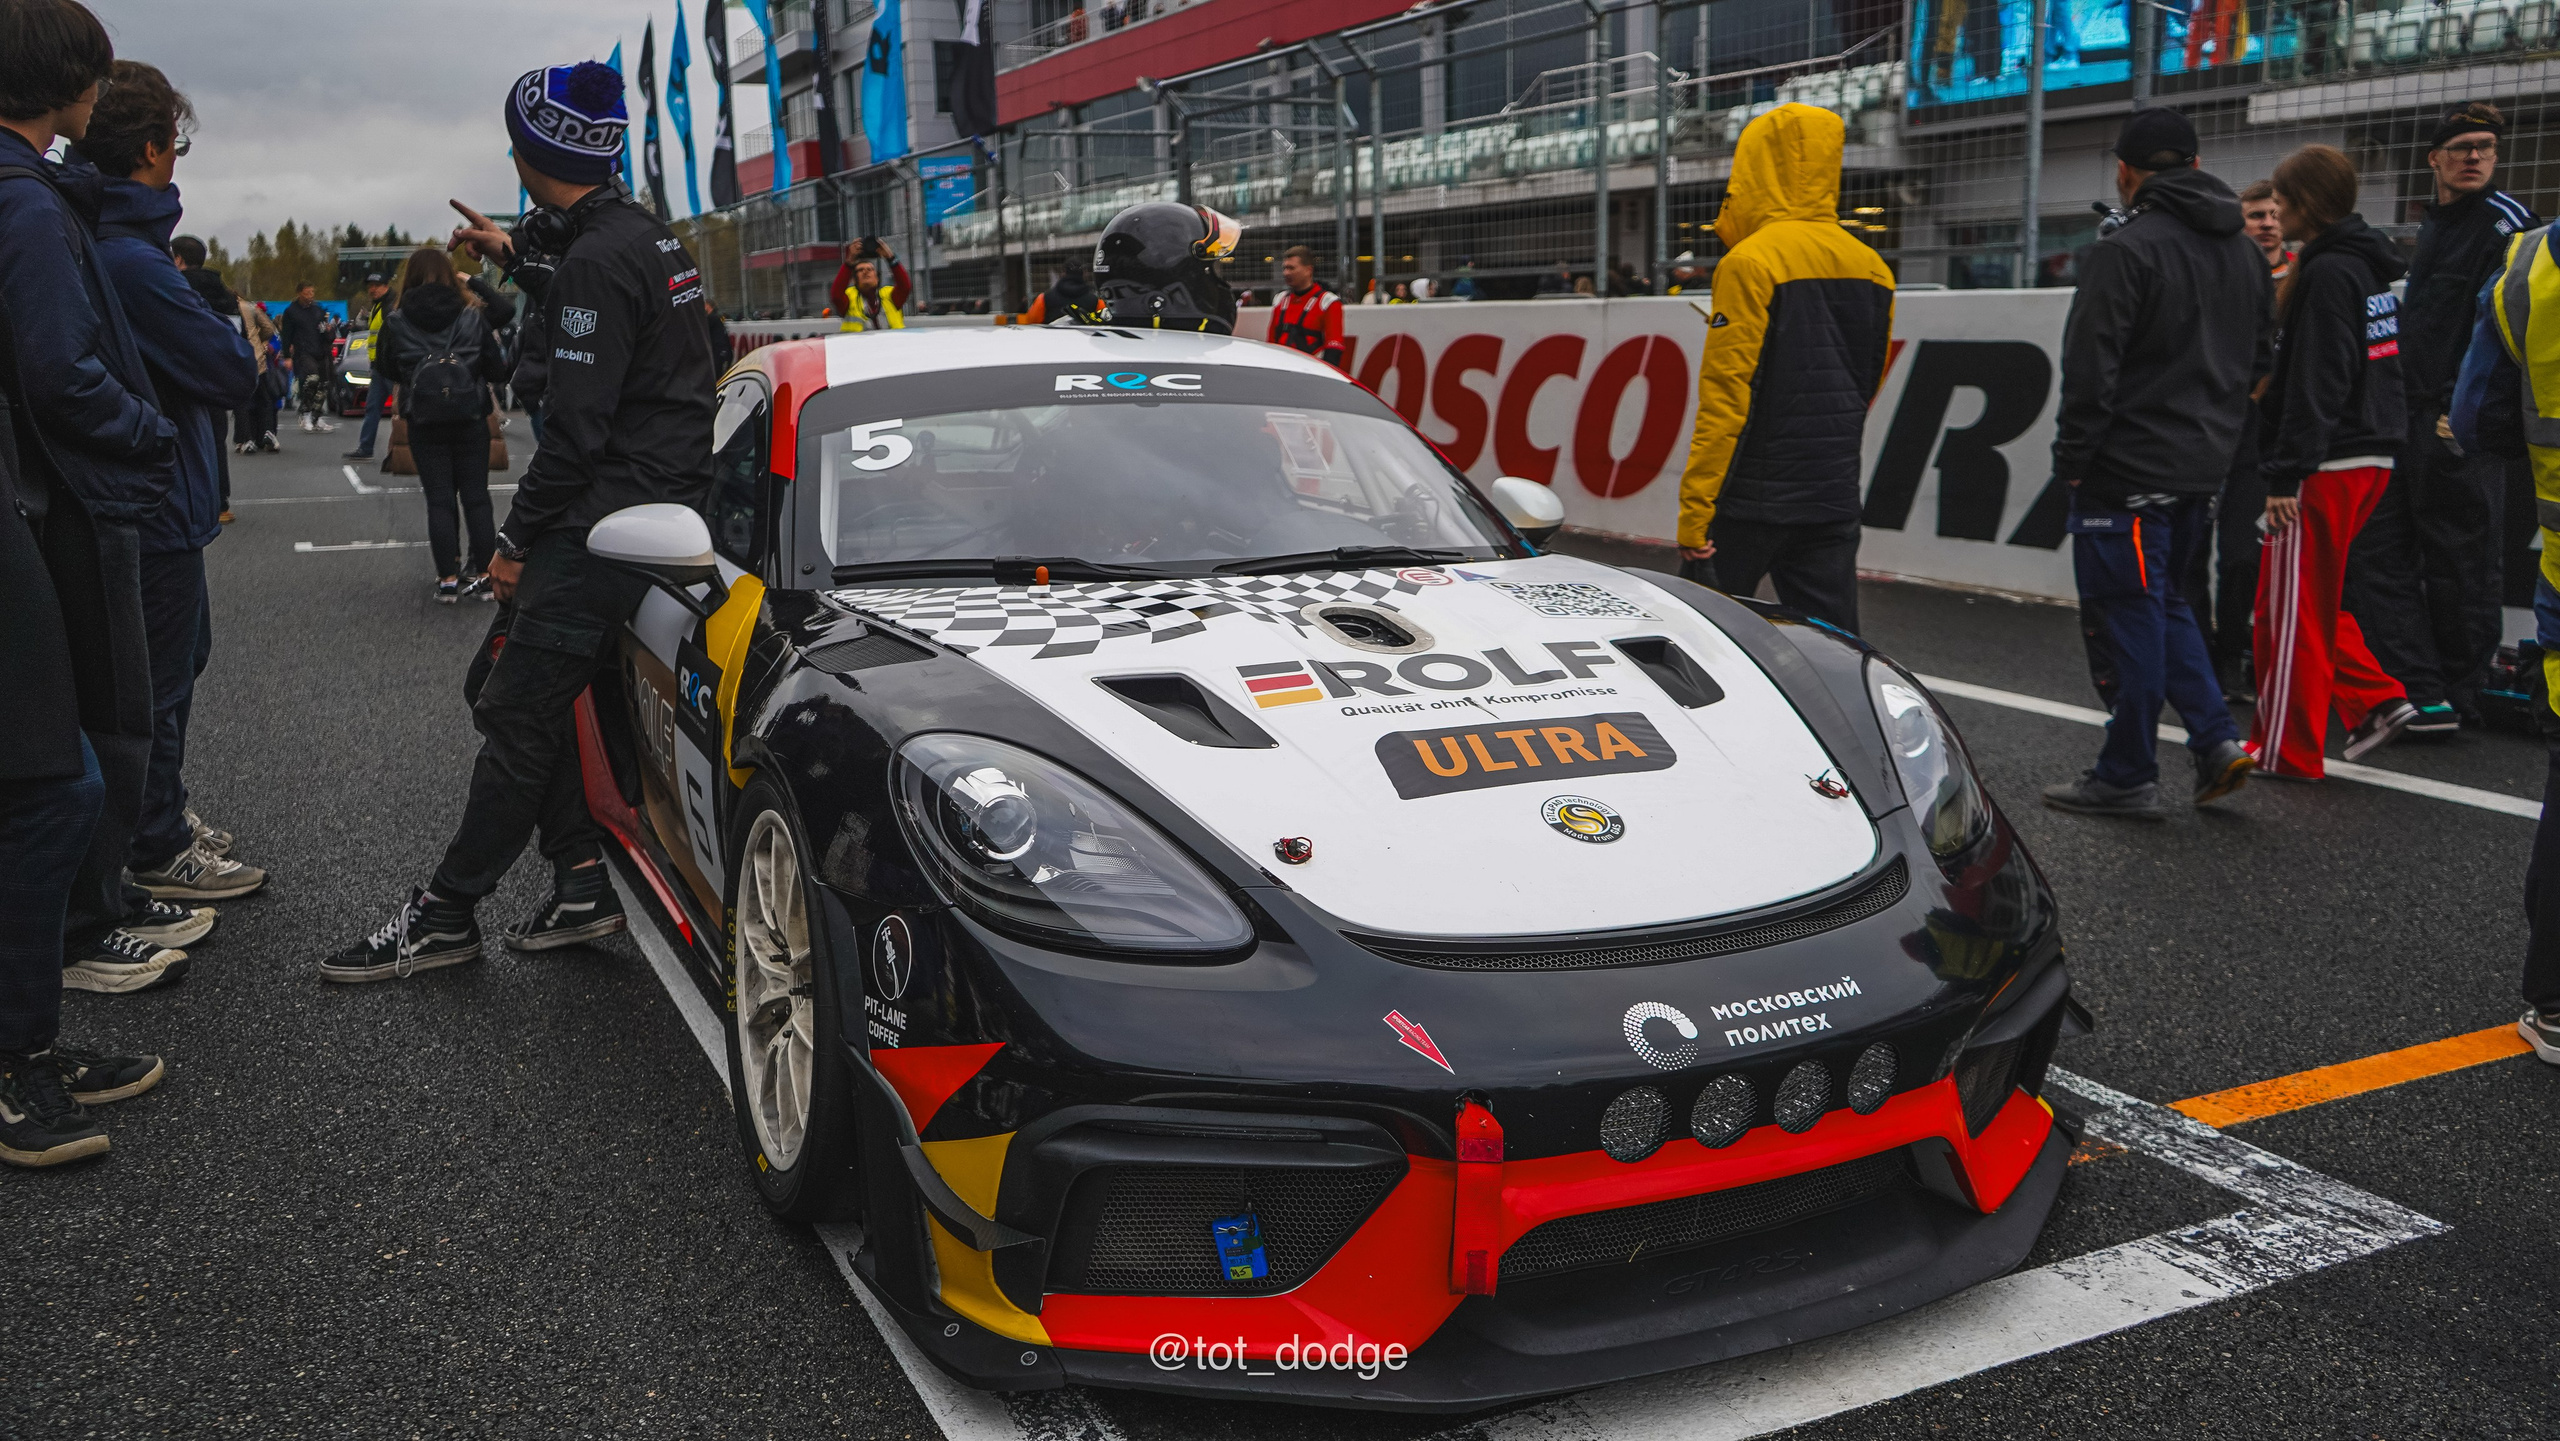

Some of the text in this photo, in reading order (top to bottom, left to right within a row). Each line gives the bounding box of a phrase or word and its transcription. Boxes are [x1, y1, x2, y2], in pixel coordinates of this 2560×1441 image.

[563, 319, 595, 335] HEUER
[566, 309, 593, 322] TAG
[555, 348, 583, 362] Mobil
[850, 418, 913, 471] 5
[1307, 641, 1617, 699] ROLF
[1340, 701, 1426, 718] Qualität
[1484, 685, 1618, 707] Kompromisse
[1412, 722, 1648, 778] ULTRA
[1563, 798, 1613, 816] technology
[1563, 827, 1590, 841] Made
[1593, 834, 1615, 842] from
[865, 995, 907, 1030] PIT-LANE
[868, 1020, 900, 1049] COFFEE
[1409, 1028, 1422, 1041] RACING
[1419, 1038, 1431, 1049] TEAM
